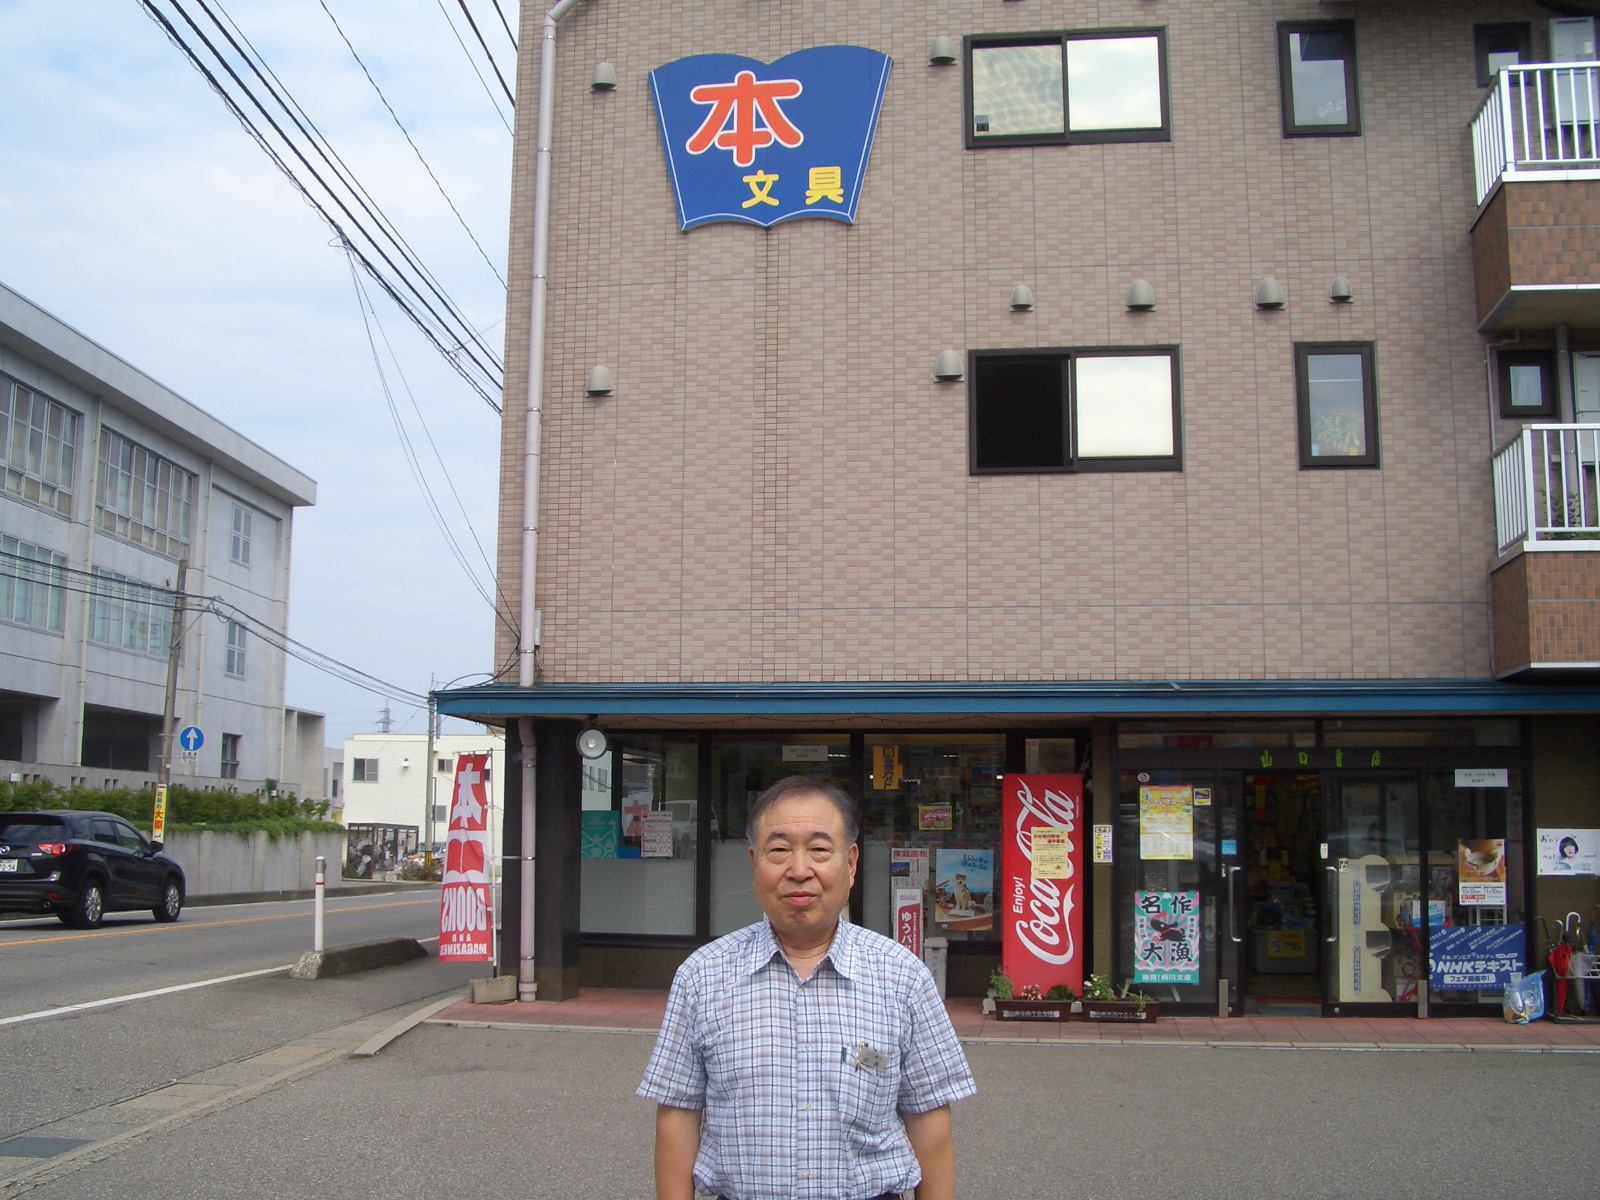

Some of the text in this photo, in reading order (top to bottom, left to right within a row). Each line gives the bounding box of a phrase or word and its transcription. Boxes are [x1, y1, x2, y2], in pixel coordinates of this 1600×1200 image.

[686, 70, 804, 167] 本
[741, 166, 844, 209] 文具
[451, 763, 482, 828] 本
[1013, 877, 1026, 914] Enjoy!
[1141, 895, 1193, 914] 名作
[1143, 942, 1193, 961] 大漁
[1437, 959, 1523, 974] NHKテキスト
